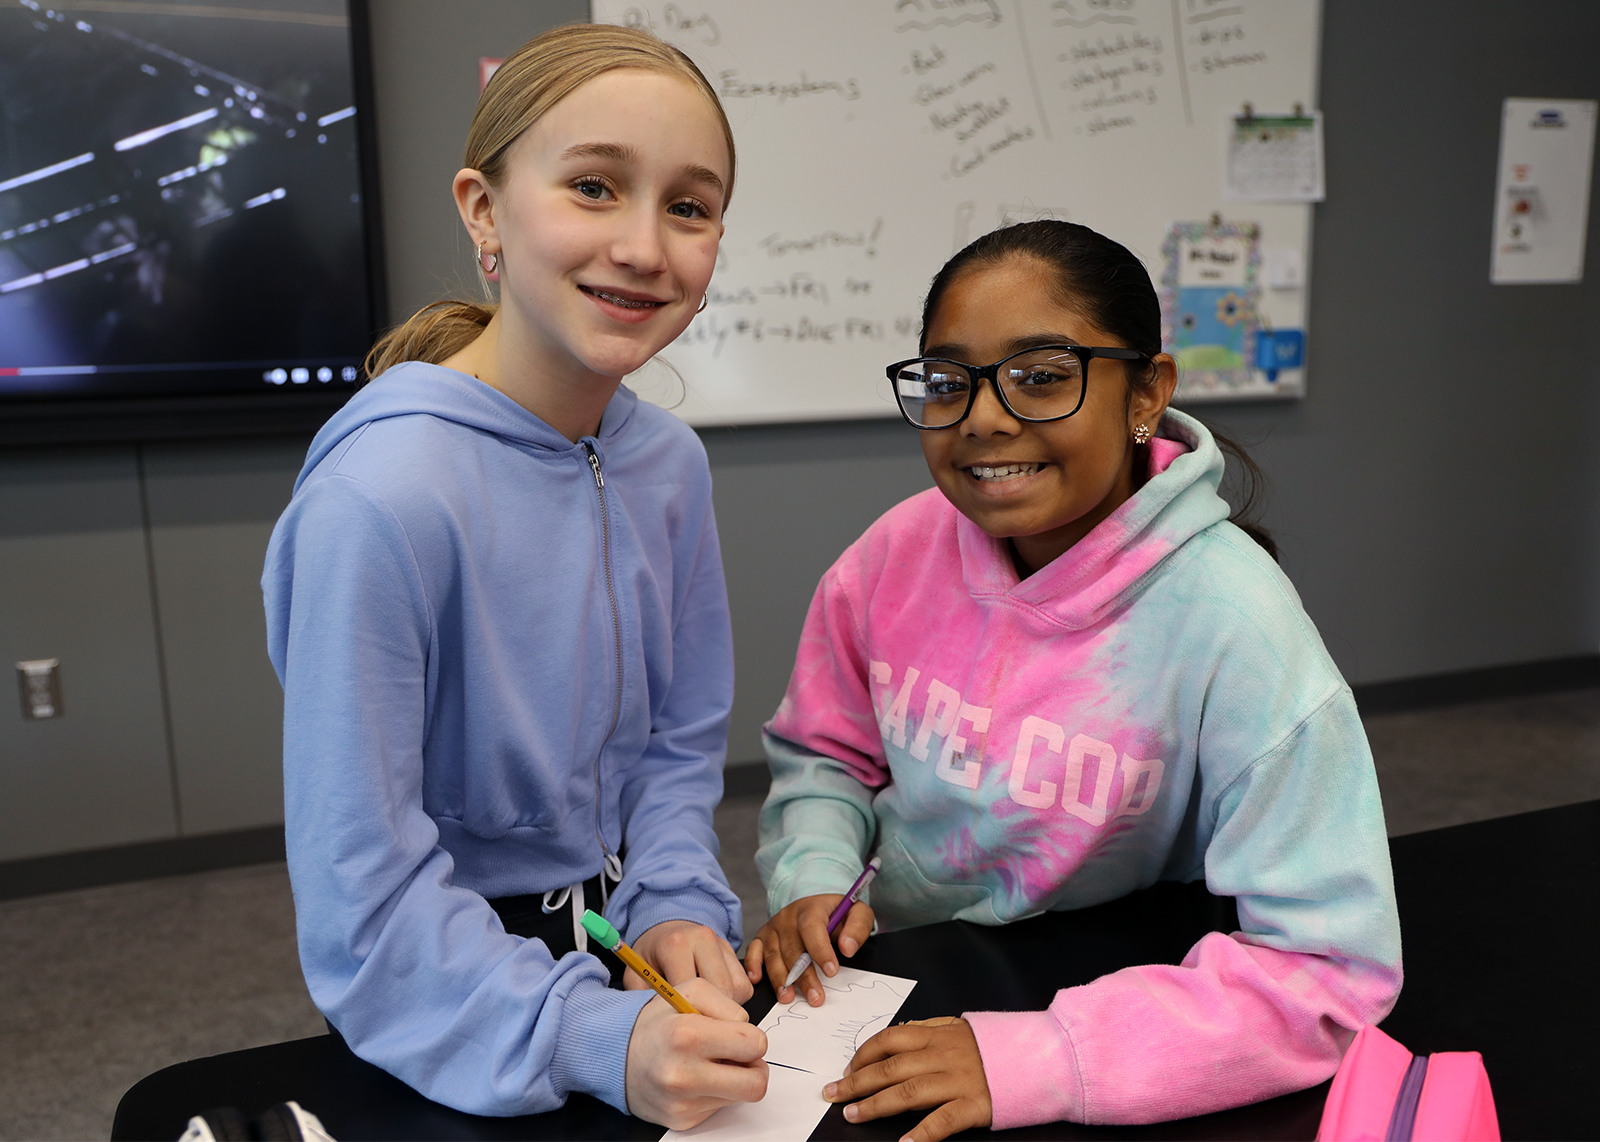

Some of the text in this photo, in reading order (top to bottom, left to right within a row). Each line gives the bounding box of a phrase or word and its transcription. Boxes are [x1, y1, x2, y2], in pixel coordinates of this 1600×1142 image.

[719, 67, 862, 104] Ecosystems
[869, 659, 1165, 828] CAPE COD
